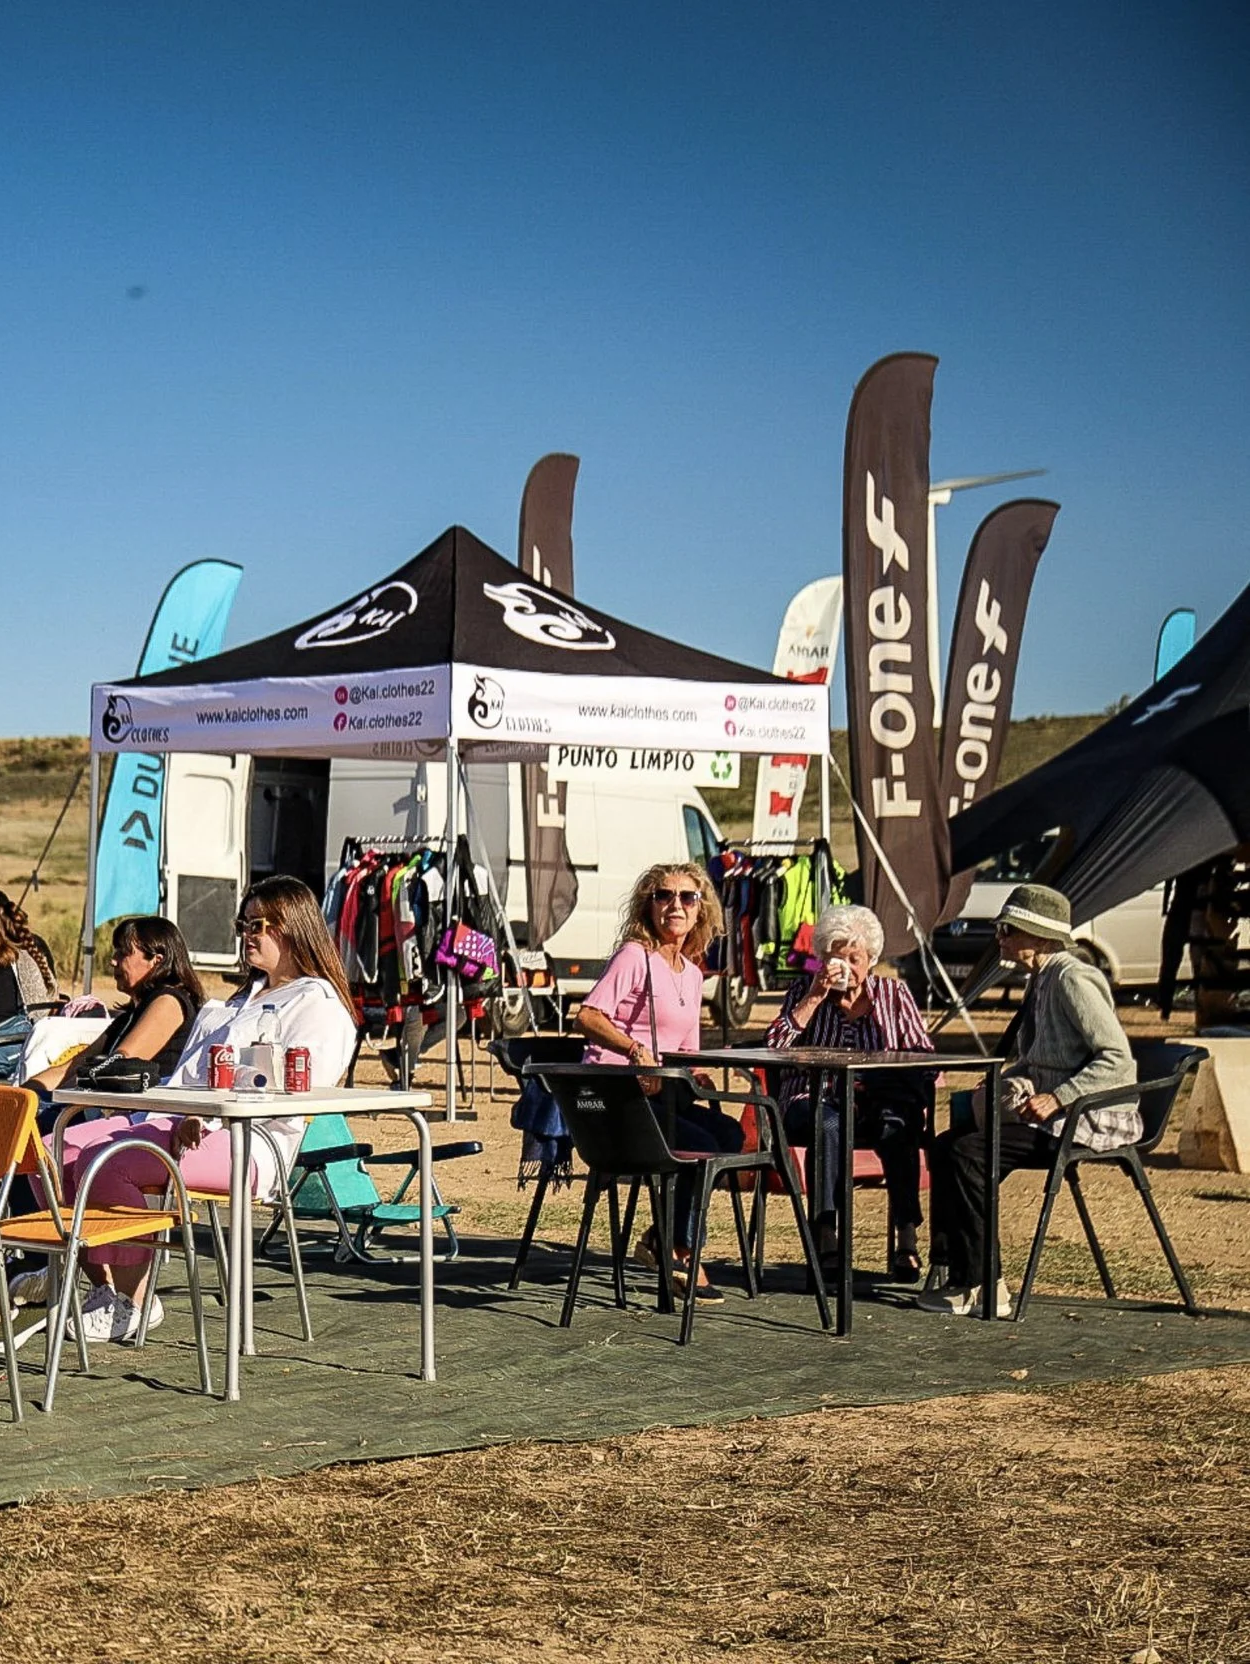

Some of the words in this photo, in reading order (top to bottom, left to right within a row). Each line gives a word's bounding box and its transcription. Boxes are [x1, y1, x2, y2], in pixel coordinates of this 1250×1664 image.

[349, 679, 435, 705] @Kai.clothes22
[868, 585, 922, 818] F-one
[578, 702, 698, 723] www.kaiclothes.com
[738, 695, 817, 713] @Kai.clothes22
[196, 706, 309, 725] www.kaiclothes.com
[349, 711, 423, 731] Kai.clothes22
[504, 715, 552, 735] CLOTHES
[131, 726, 170, 744] CLOTHES
[557, 745, 618, 770] PUNTO
[630, 750, 695, 772] LIMPIO
